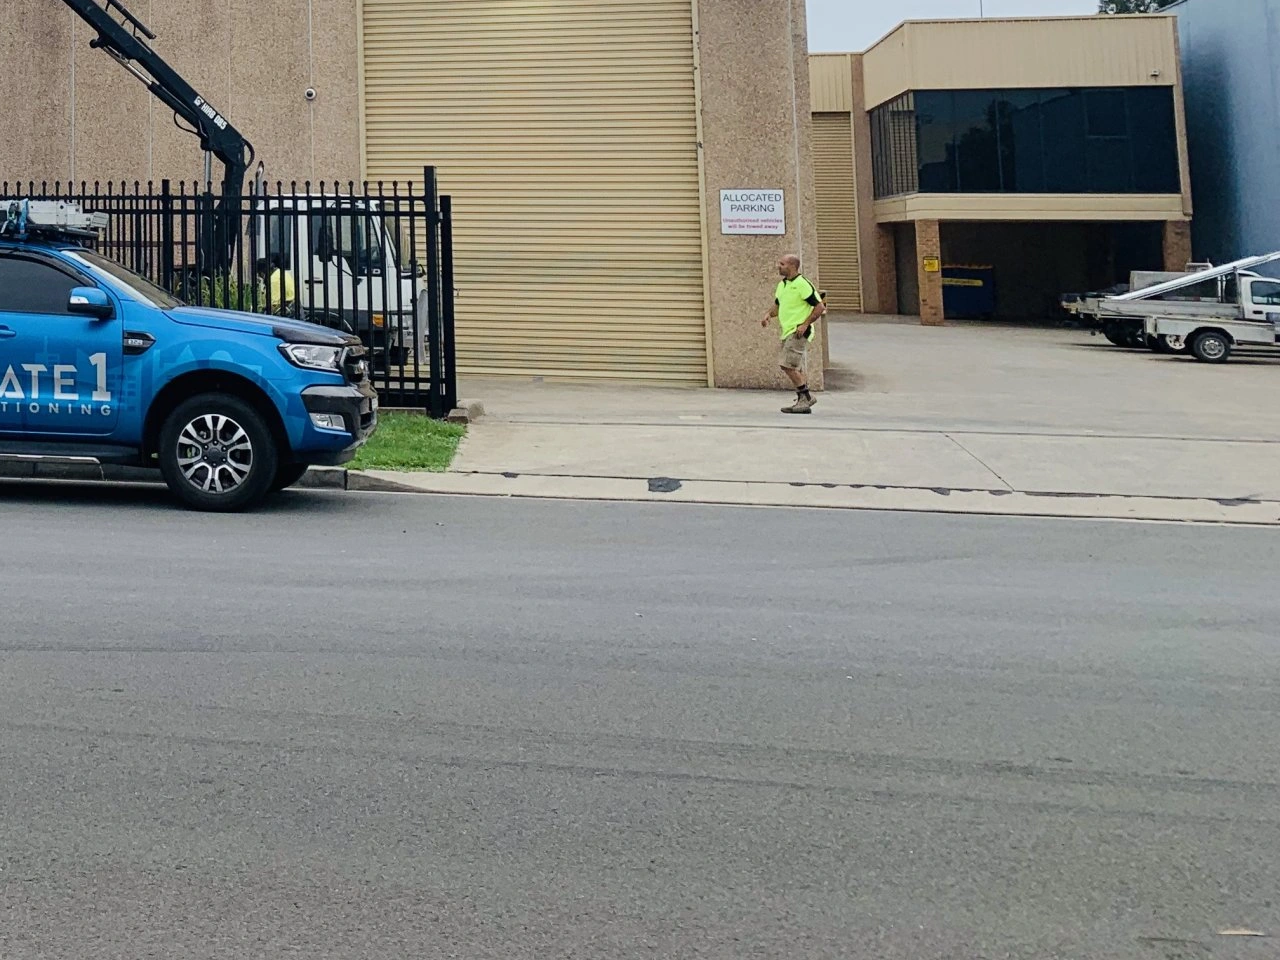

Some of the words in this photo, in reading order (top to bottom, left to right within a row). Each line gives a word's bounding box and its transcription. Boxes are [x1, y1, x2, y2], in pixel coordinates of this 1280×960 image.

[201, 102, 216, 119] HIAB
[723, 193, 782, 202] ALLOCATED
[730, 204, 775, 212] PARKING
